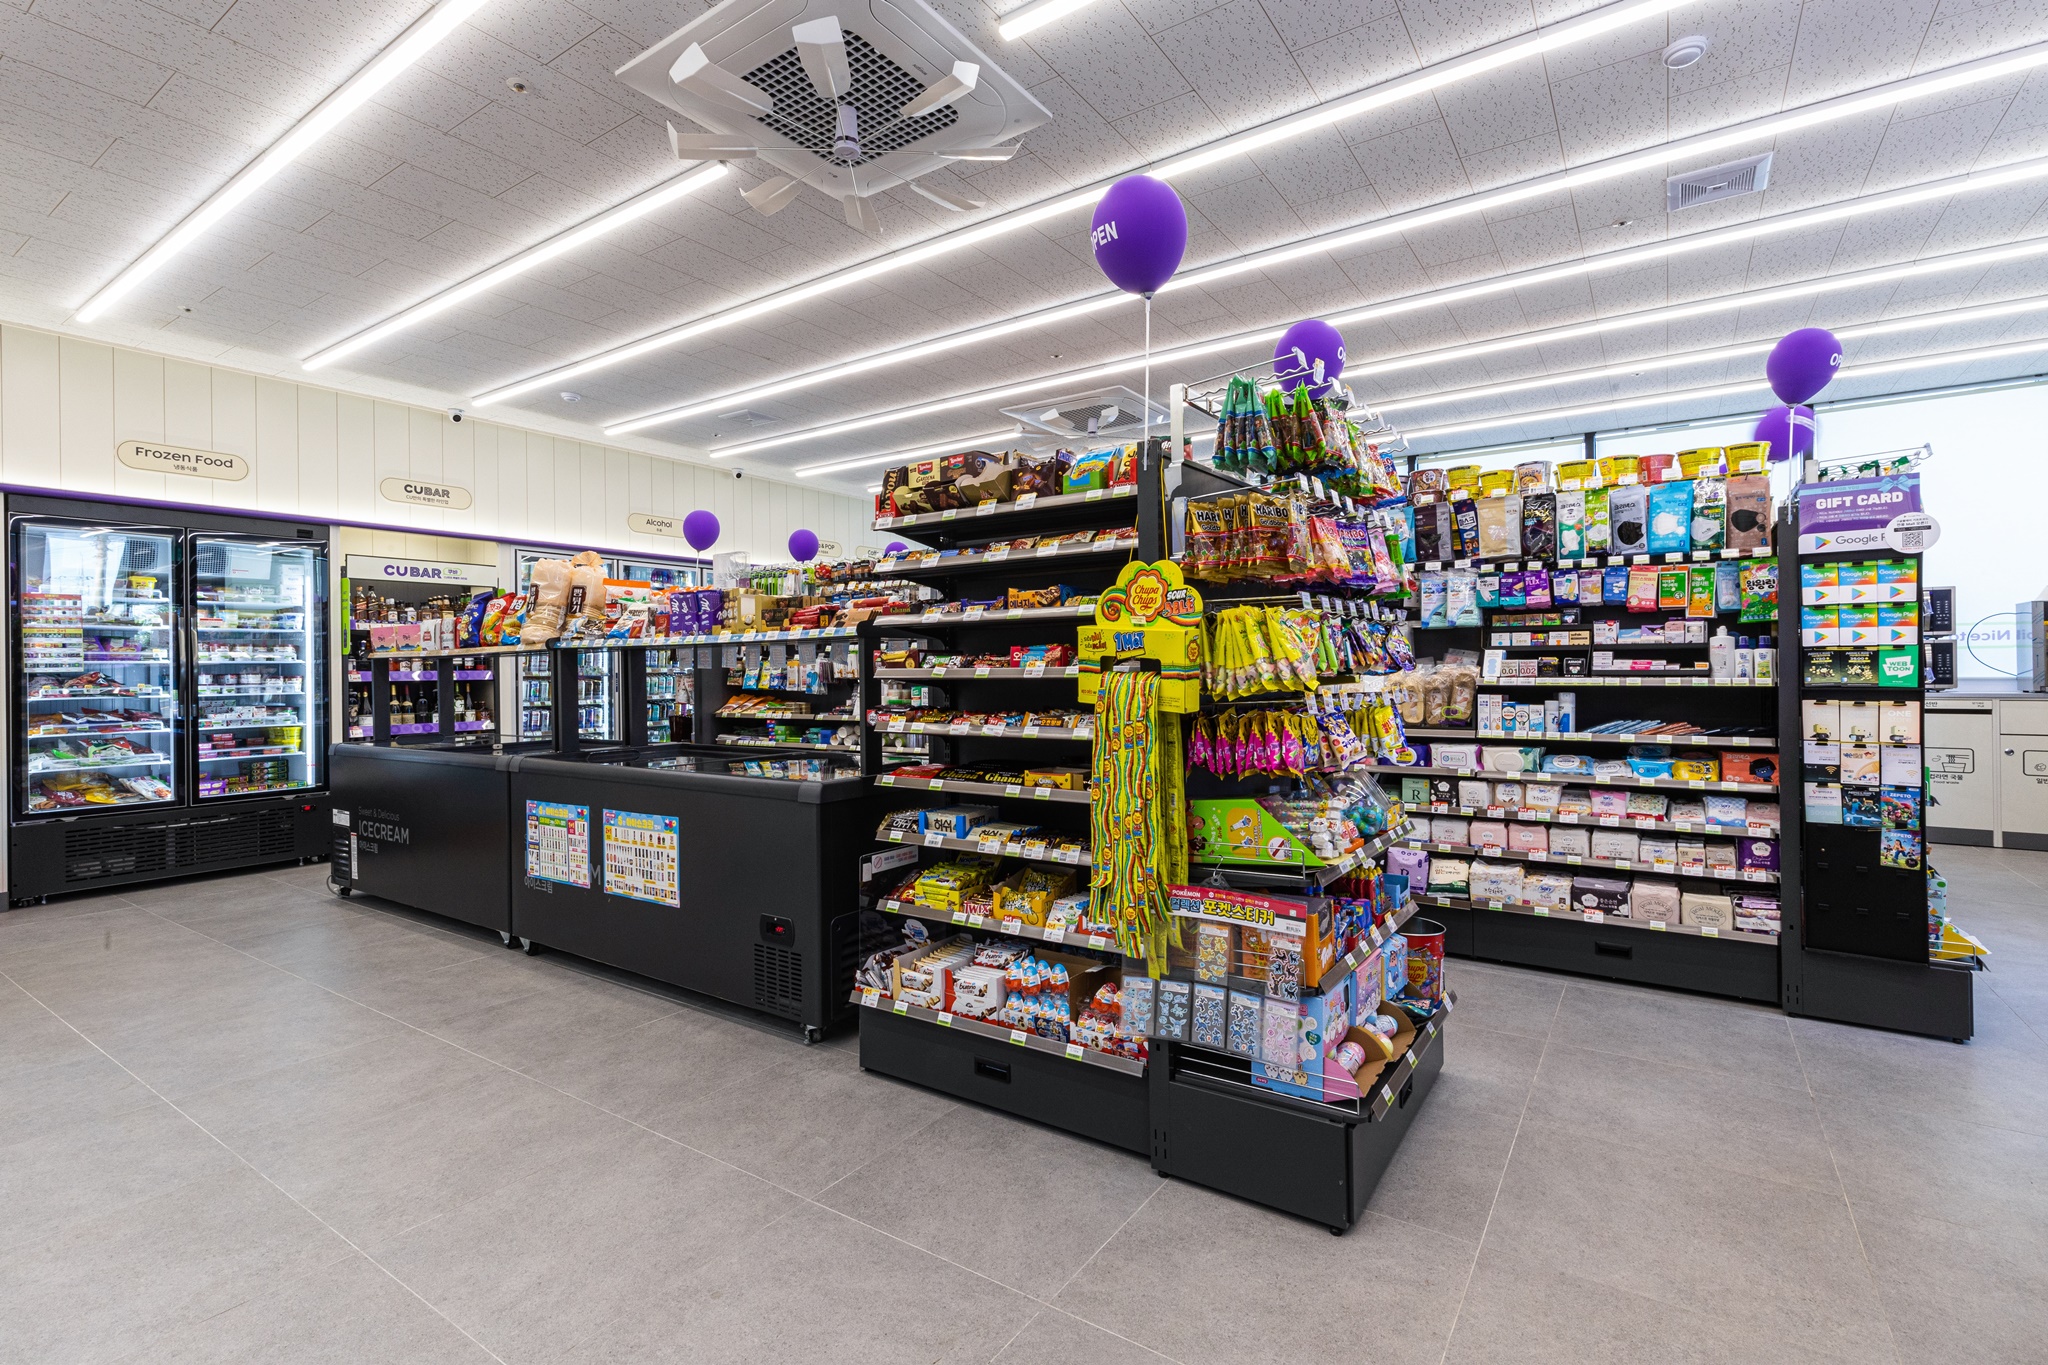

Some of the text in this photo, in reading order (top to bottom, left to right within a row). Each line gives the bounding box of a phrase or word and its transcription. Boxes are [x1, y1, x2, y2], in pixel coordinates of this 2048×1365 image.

[1091, 221, 1118, 254] PEN
[135, 446, 233, 468] Frozen Food
[173, 464, 198, 472] 냉동식품
[404, 484, 450, 498] CUBAR
[1816, 491, 1903, 509] GIFT CARD
[1255, 504, 1288, 518] HARIBO
[646, 519, 673, 528] Alcohol
[1835, 533, 1878, 545] Google
[383, 564, 442, 579] CUBAR
[1134, 585, 1159, 595] Chupa
[571, 588, 583, 614] 뻥튀기
[1132, 594, 1157, 606] Chups
[1520, 667, 1536, 675] 0.02
[939, 770, 980, 780] Ghana
[985, 772, 1023, 784] Ghana
[1412, 789, 1421, 800] R
[934, 818, 953, 832] 허쉬
[358, 819, 409, 845] ICECREAM
[524, 877, 553, 894] 아이스크림
[1172, 889, 1201, 897] POKÉMON
[963, 901, 990, 915] TWIX
[1170, 898, 1275, 926] 컬렉션 포켓스티커
[985, 951, 1003, 959] bueno
[1408, 964, 1425, 974] upa
[1408, 972, 1425, 981] ups
